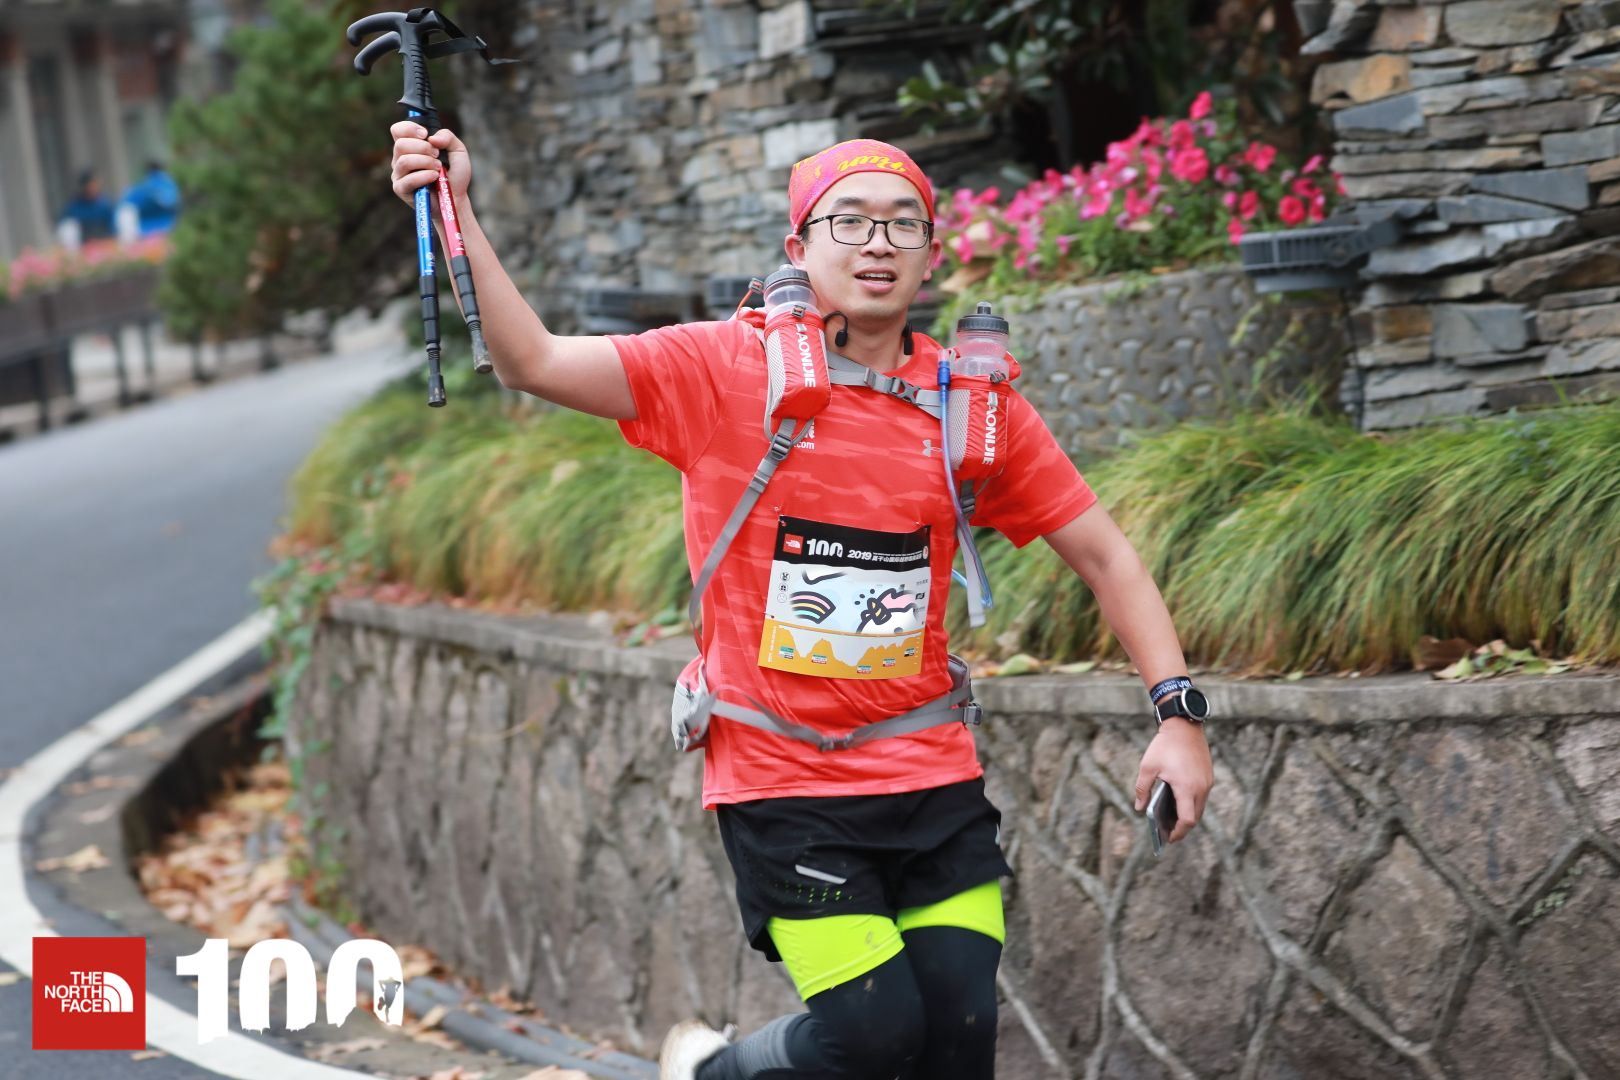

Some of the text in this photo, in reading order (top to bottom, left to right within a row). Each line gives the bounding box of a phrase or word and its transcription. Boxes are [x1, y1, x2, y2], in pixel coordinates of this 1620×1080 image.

[796, 332, 816, 388] AONIJIE
[806, 538, 844, 558] 100
[847, 549, 872, 561] 2019
